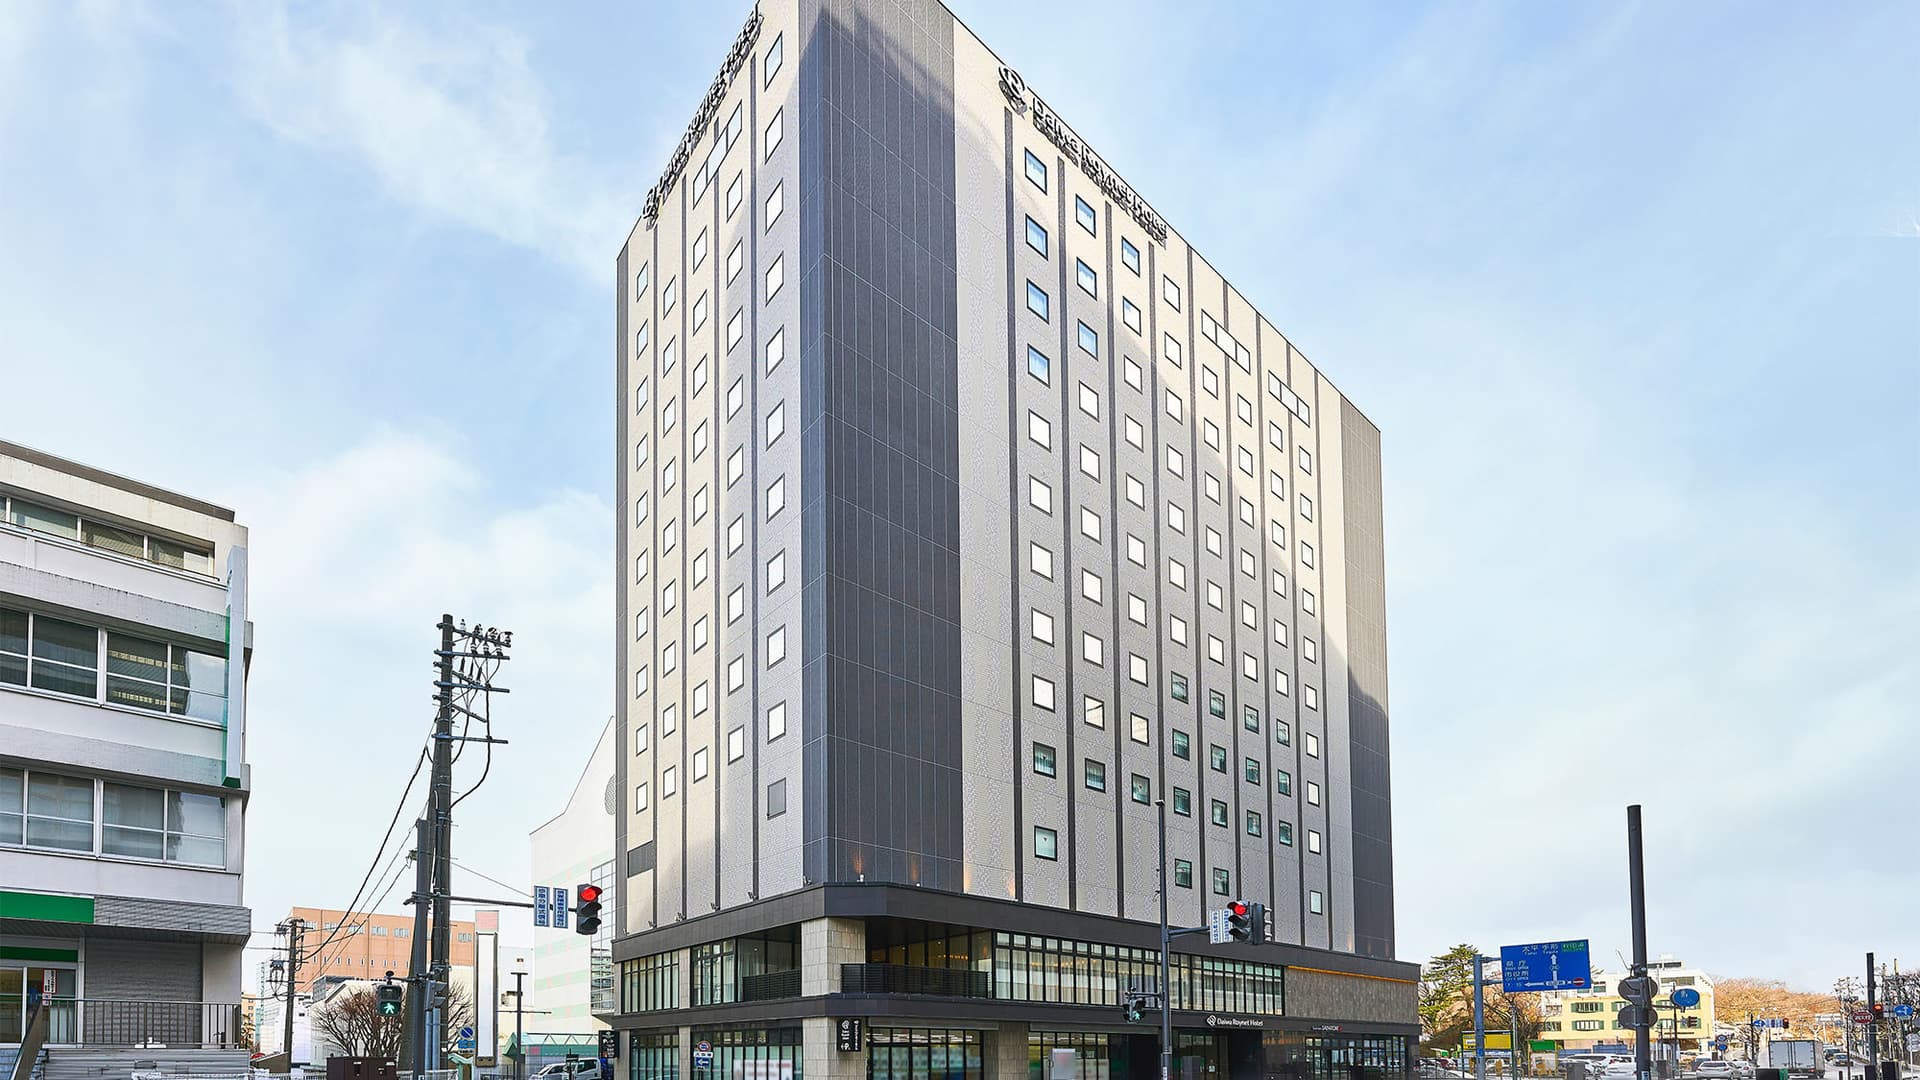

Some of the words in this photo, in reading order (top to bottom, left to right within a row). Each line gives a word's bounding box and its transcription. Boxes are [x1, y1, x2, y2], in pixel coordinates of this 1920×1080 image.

[1033, 97, 1080, 155] Daiwa
[1081, 144, 1132, 205] Roynet
[1133, 195, 1168, 239] Hotel
[1233, 1018, 1249, 1027] Roynet
